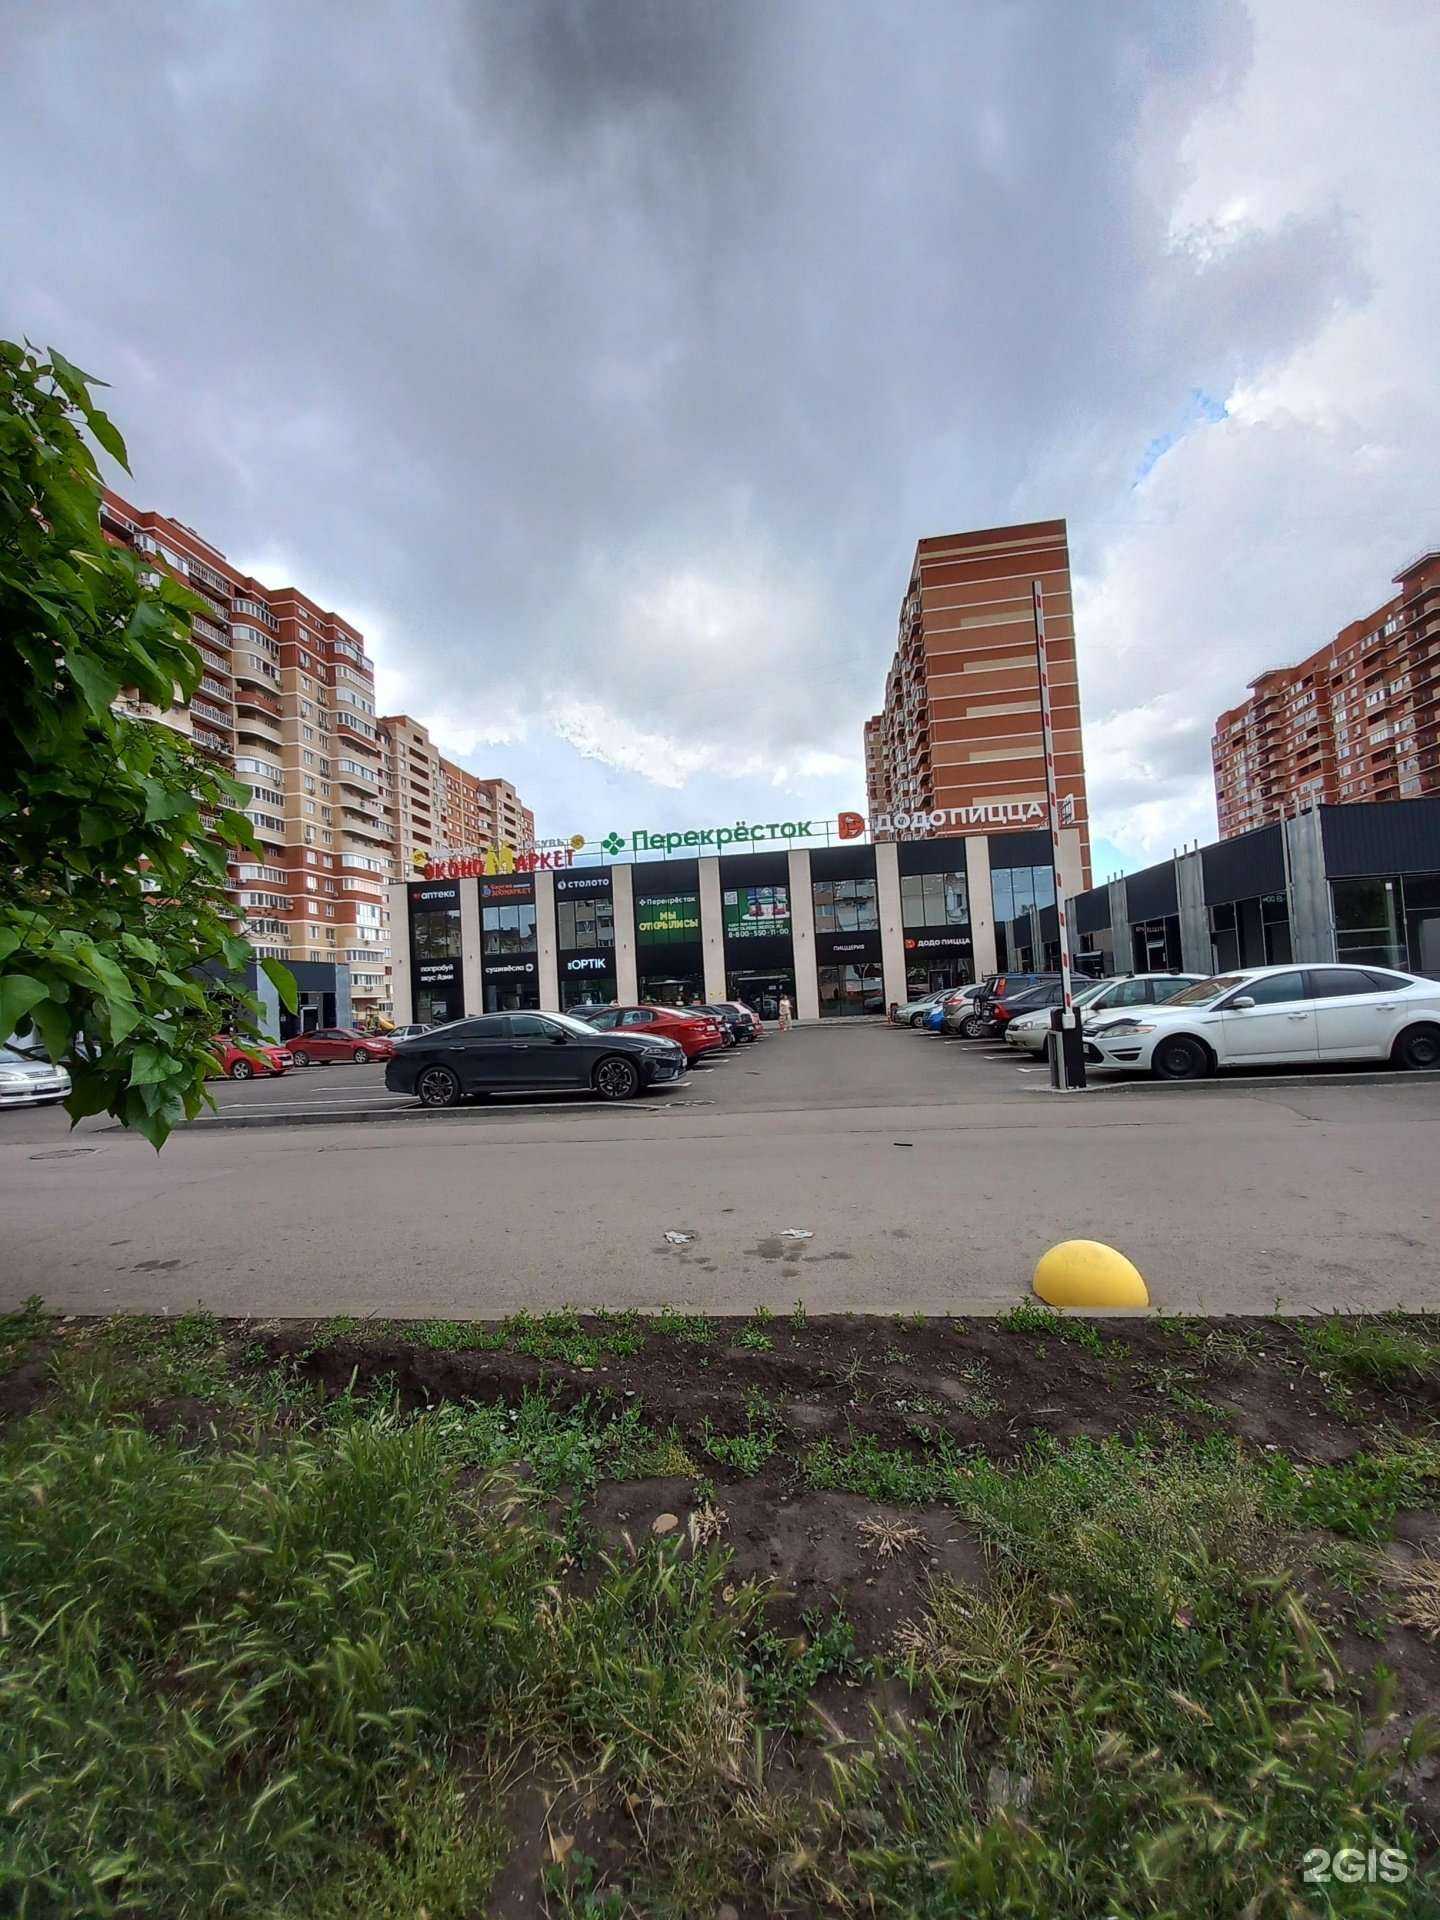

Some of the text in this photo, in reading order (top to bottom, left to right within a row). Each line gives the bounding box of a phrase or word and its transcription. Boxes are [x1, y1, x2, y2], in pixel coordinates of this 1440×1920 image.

[950, 802, 1044, 826] ПИЦЦА
[632, 821, 812, 854] Перекрёсток
[568, 877, 609, 889] СТОЛОТО
[659, 911, 677, 920] МЫ
[941, 937, 971, 945] ПИЦЦА
